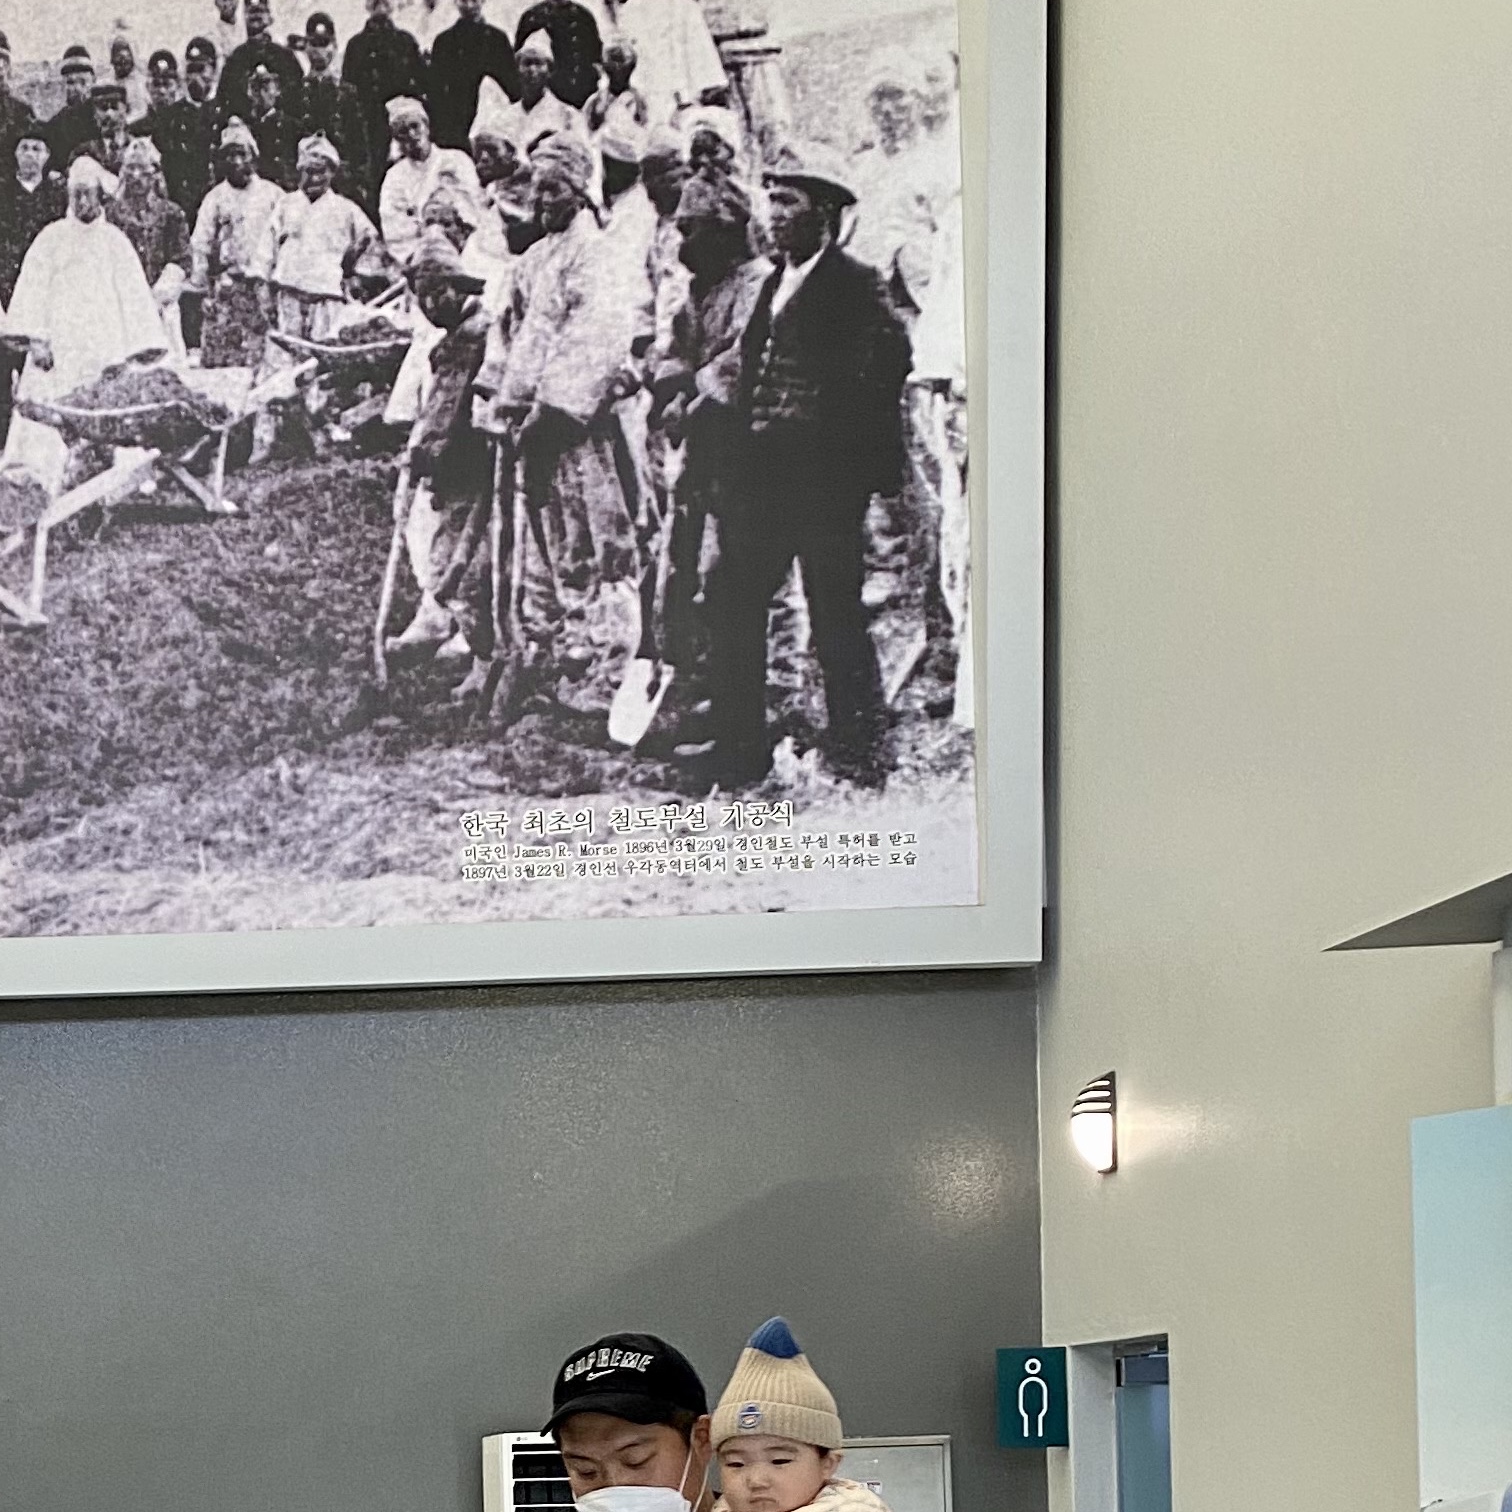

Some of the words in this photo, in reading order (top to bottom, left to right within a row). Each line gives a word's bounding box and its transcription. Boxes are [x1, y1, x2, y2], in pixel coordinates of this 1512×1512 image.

[462, 812, 509, 838] 한국
[523, 809, 594, 834] 최초의
[610, 805, 707, 832] 철도부설
[722, 802, 793, 829] 기공식
[464, 845, 507, 861] 미국인
[514, 845, 551, 859] James
[558, 845, 572, 857] R.
[580, 843, 617, 856] Morse
[625, 840, 668, 855] 1896년
[675, 838, 727, 852] 3월29일
[735, 836, 793, 851] 경인철도
[800, 834, 829, 849] 부설
[838, 833, 881, 848] 특허를
[889, 832, 918, 847] 받고
[463, 865, 507, 880] 1897년
[515, 863, 566, 878] 3월22일
[574, 861, 617, 877] 경인선
[735, 857, 764, 872] 철도
[772, 855, 815, 870] 부설을
[823, 853, 881, 869] 시작하는
[889, 851, 918, 866] 모습
[564, 1348, 654, 1382] SUPREME
